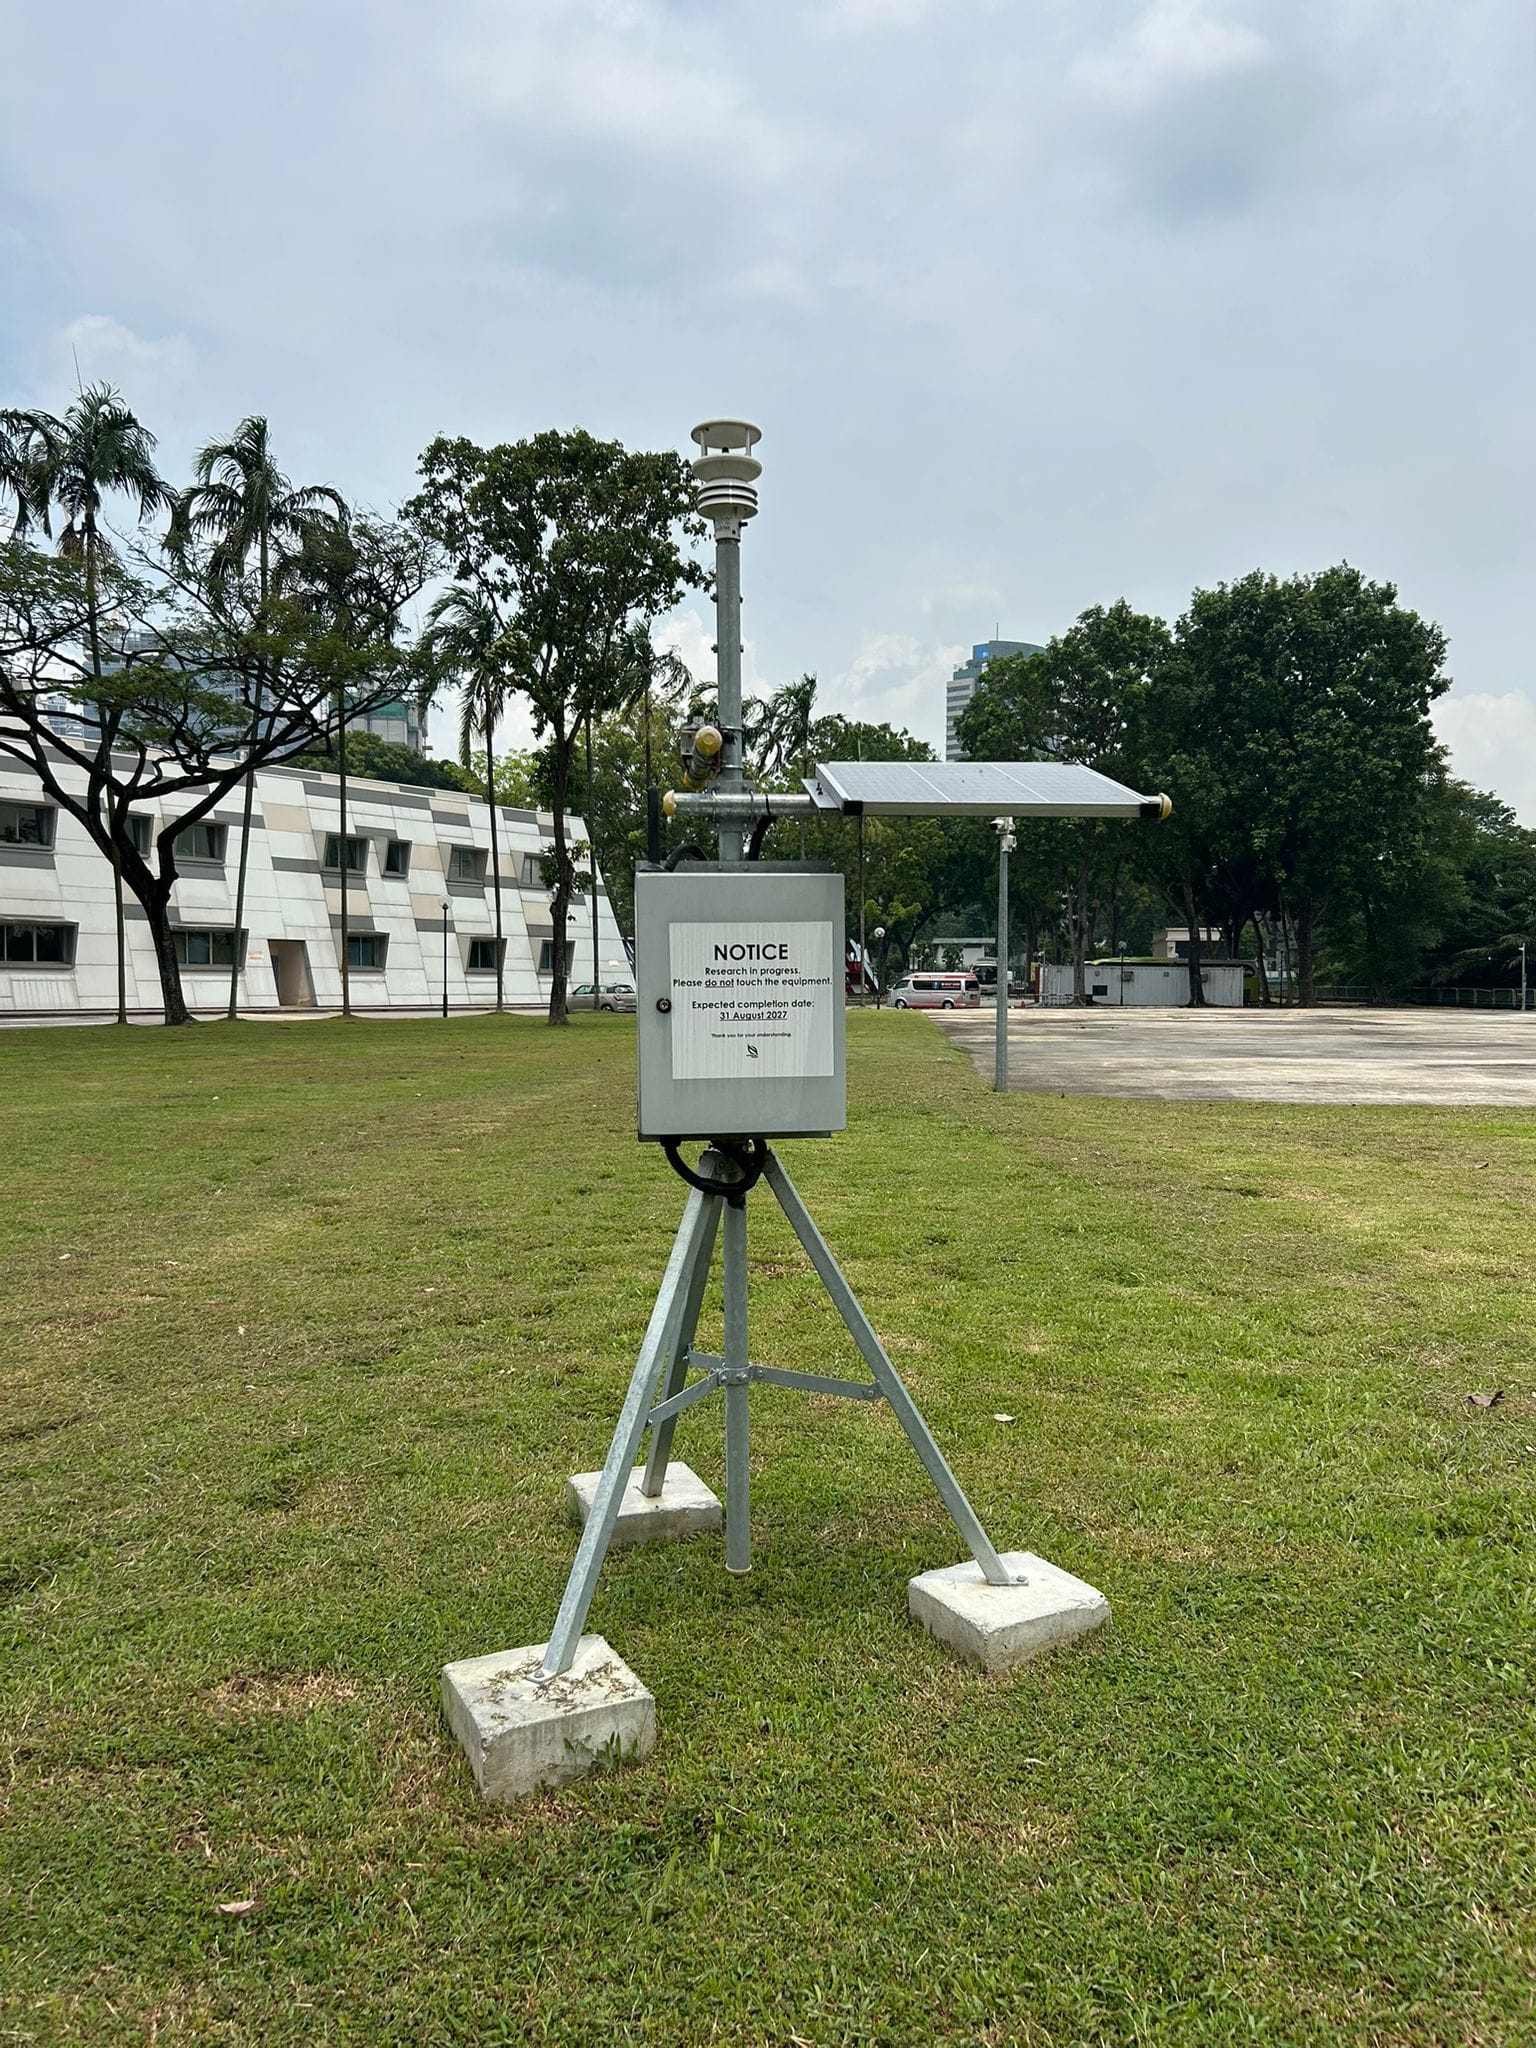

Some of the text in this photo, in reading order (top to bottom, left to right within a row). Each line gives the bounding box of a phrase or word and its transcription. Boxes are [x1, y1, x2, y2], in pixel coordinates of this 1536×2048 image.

[714, 944, 788, 960] NOTICE
[705, 966, 801, 977] Research in progress.
[673, 976, 833, 988] Please do not touch the equipment.
[692, 999, 815, 1011] Expected completion date:
[720, 1010, 787, 1021] 31 August 2027
